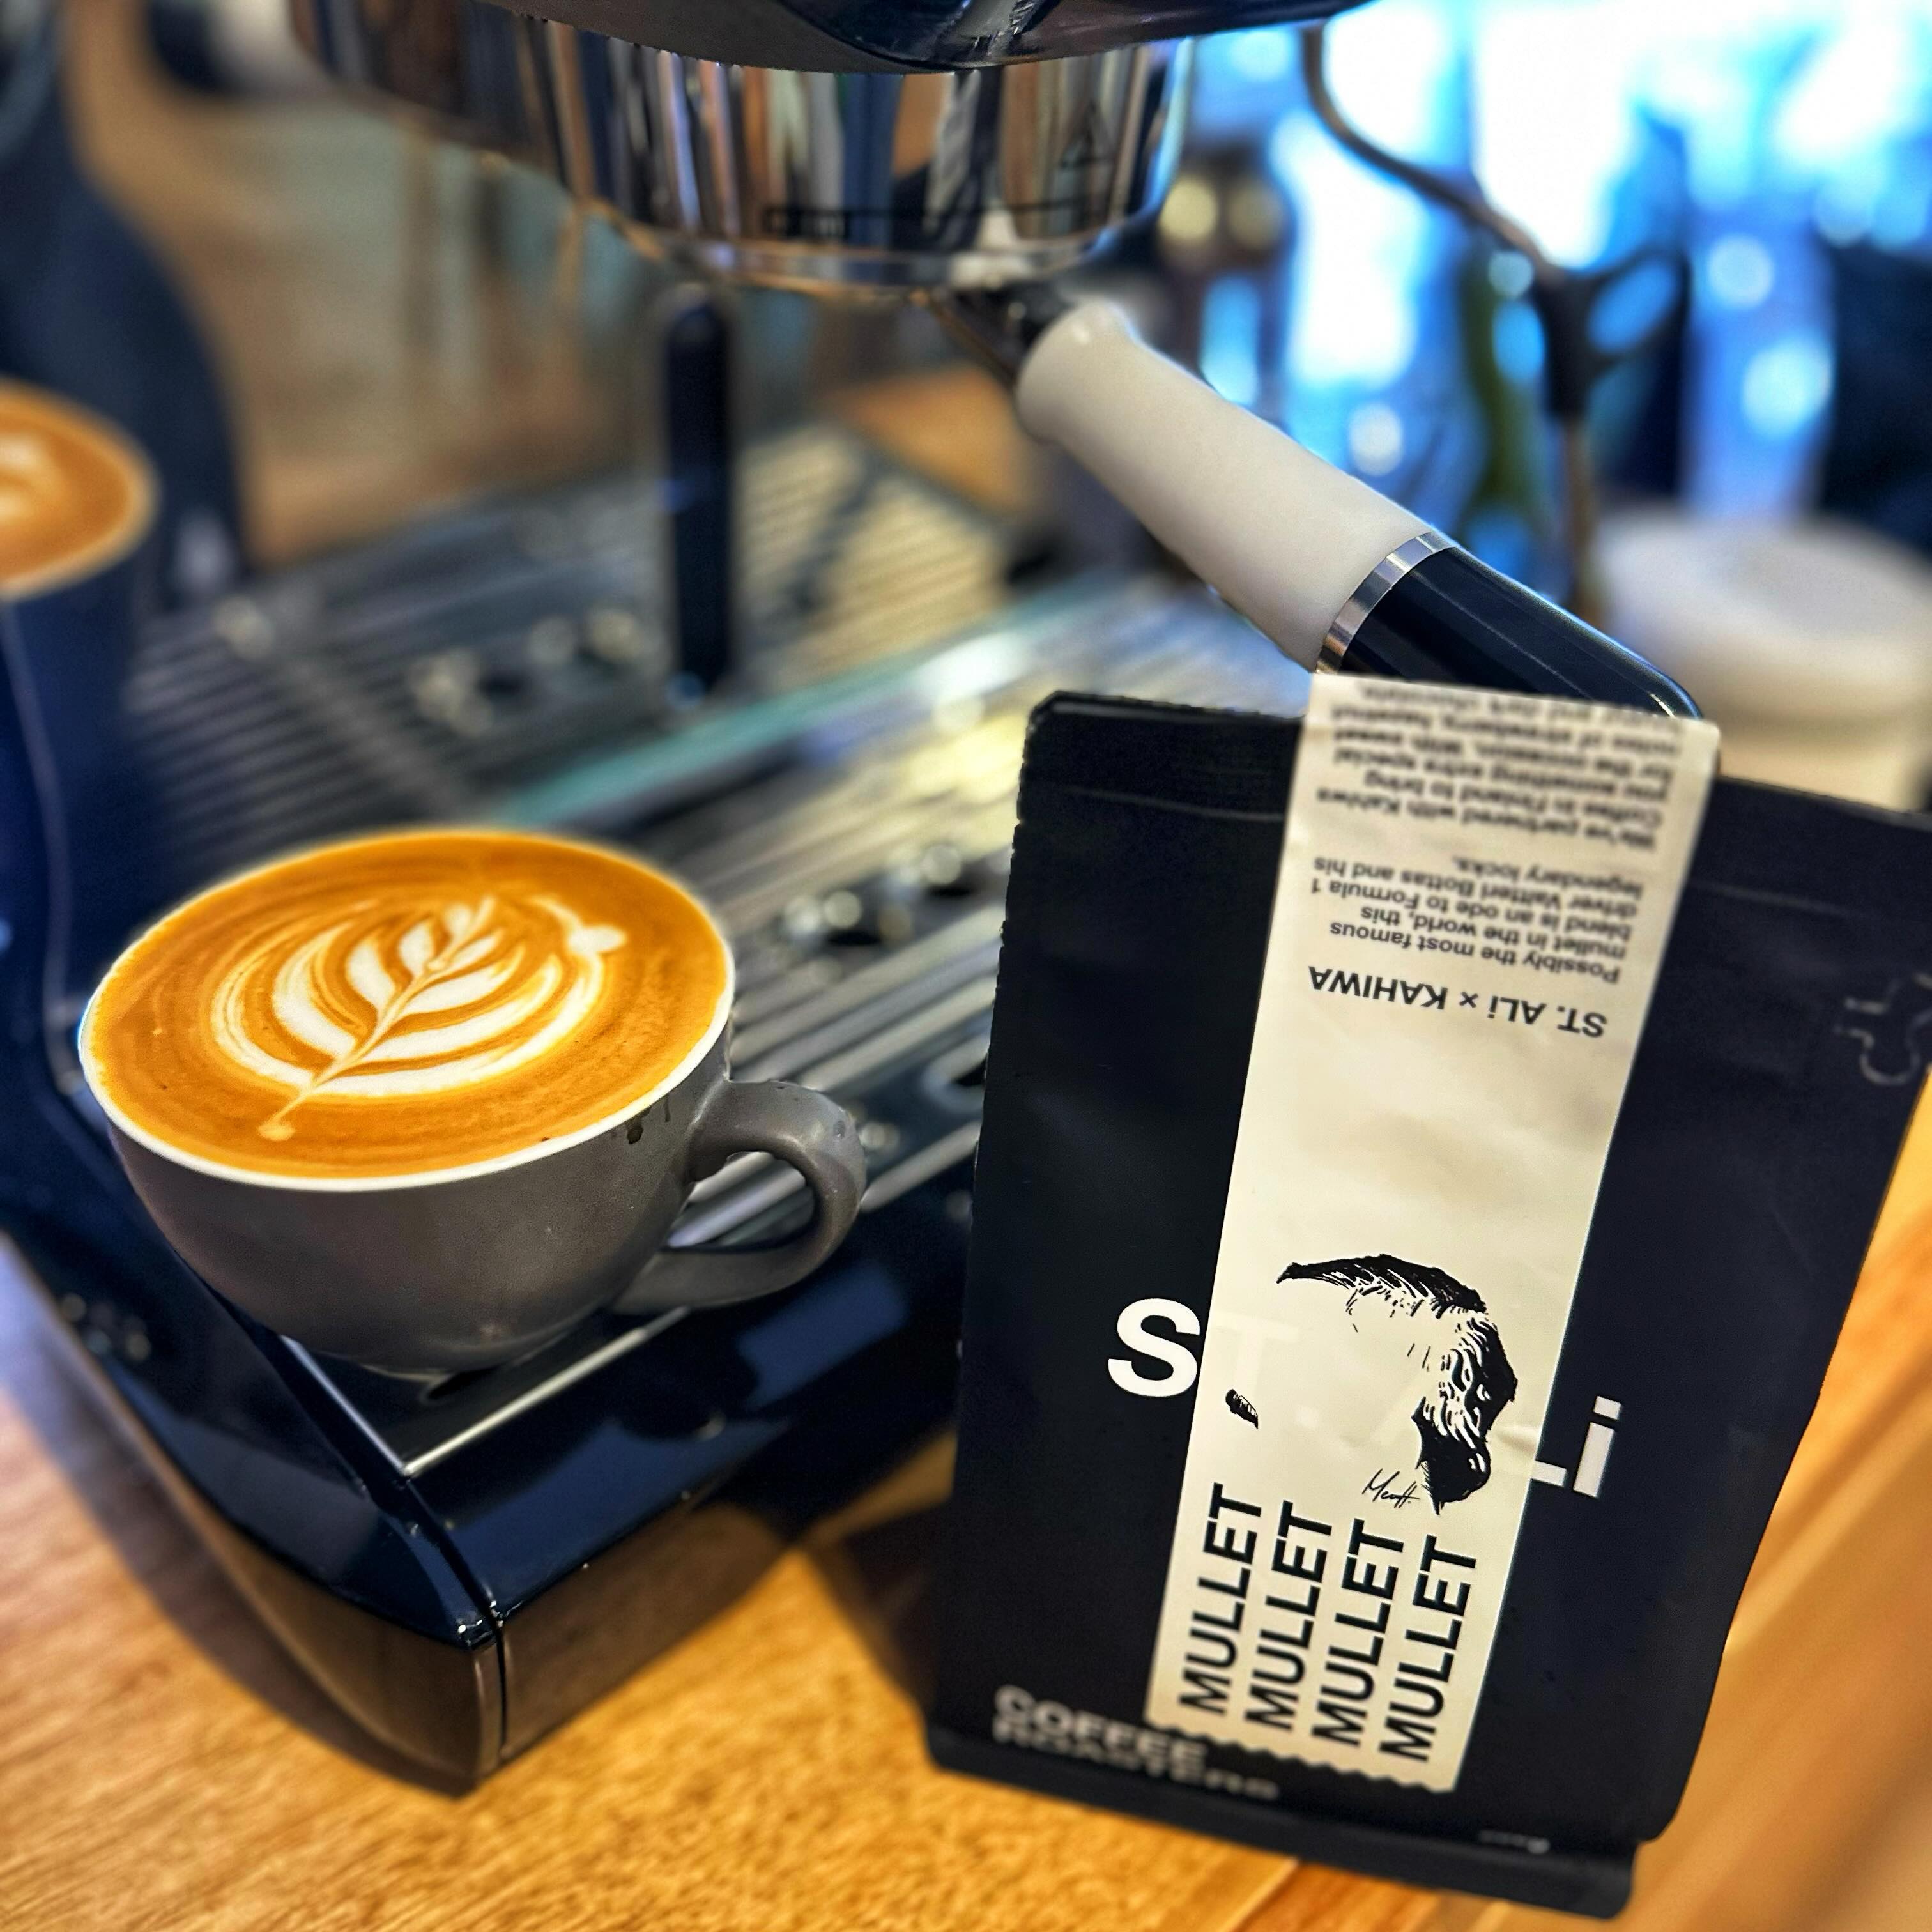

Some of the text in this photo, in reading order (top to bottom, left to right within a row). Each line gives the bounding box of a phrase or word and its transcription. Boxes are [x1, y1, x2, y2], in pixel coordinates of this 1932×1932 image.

[1316, 787, 1400, 815] Kahiwa
[1363, 770, 1661, 829] Coffee in Finland to bring
[1407, 800, 1455, 818] with
[1461, 807, 1578, 835] partnered
[1314, 856, 1637, 919] driver Valtteri Bottas and his
[1452, 856, 1642, 901] legendary locks.
[1310, 878, 1630, 942] blend is an ode to Formula 1
[1360, 906, 1625, 959] mullet in the world, this
[1330, 921, 1620, 984] Possibly the most famous
[1308, 965, 1448, 1009] KAHIWA
[1487, 995, 1546, 1025] ALi
[1556, 1005, 1607, 1038] ST.
[1178, 1482, 1262, 1716] MULLET
[1244, 1499, 1332, 1730] MULLET
[1311, 1517, 1404, 1747] MULLET
[1379, 1534, 1476, 1763] MULLET
[995, 1684, 1207, 1760] COFFEE
